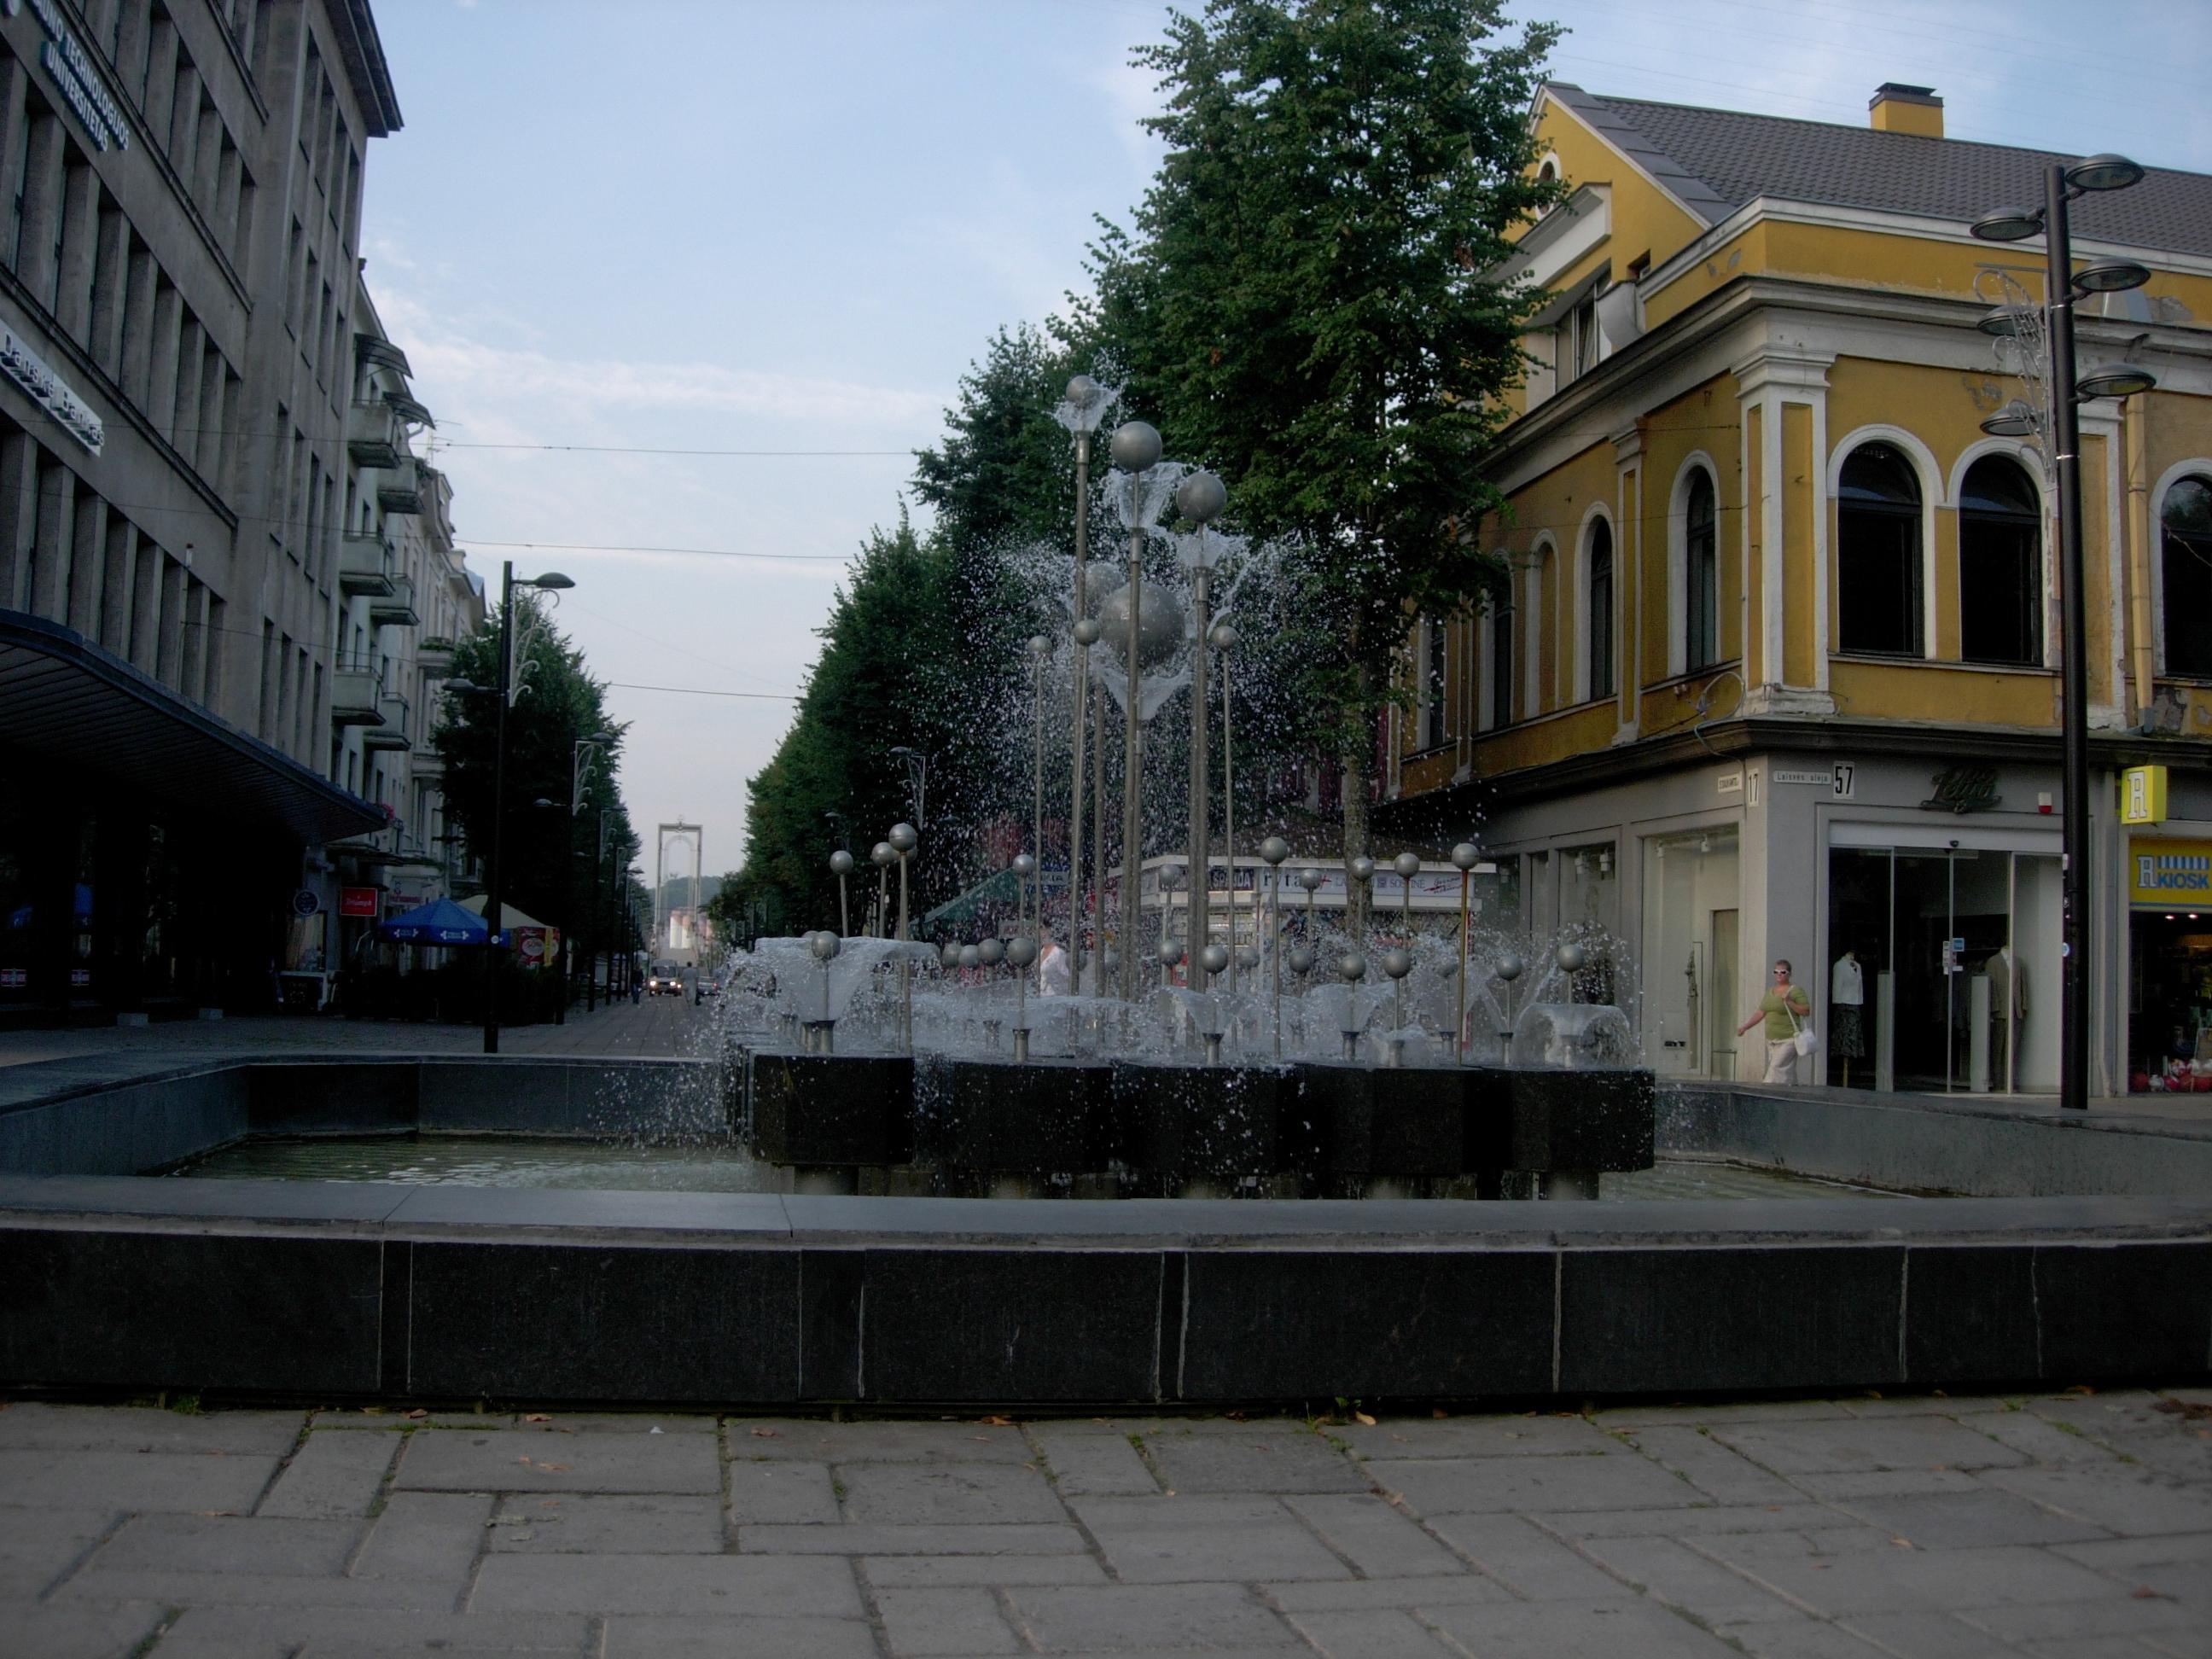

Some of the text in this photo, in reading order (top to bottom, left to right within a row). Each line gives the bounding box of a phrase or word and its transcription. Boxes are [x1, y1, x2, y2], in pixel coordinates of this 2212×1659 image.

[48, 41, 109, 151] UNIVERSITETAS
[65, 32, 130, 151] TECHNOLOGIJOS
[1749, 773, 1758, 802] 17
[1835, 765, 1853, 795] 57
[2128, 771, 2147, 820] R
[2137, 854, 2209, 888] R KIOSK
